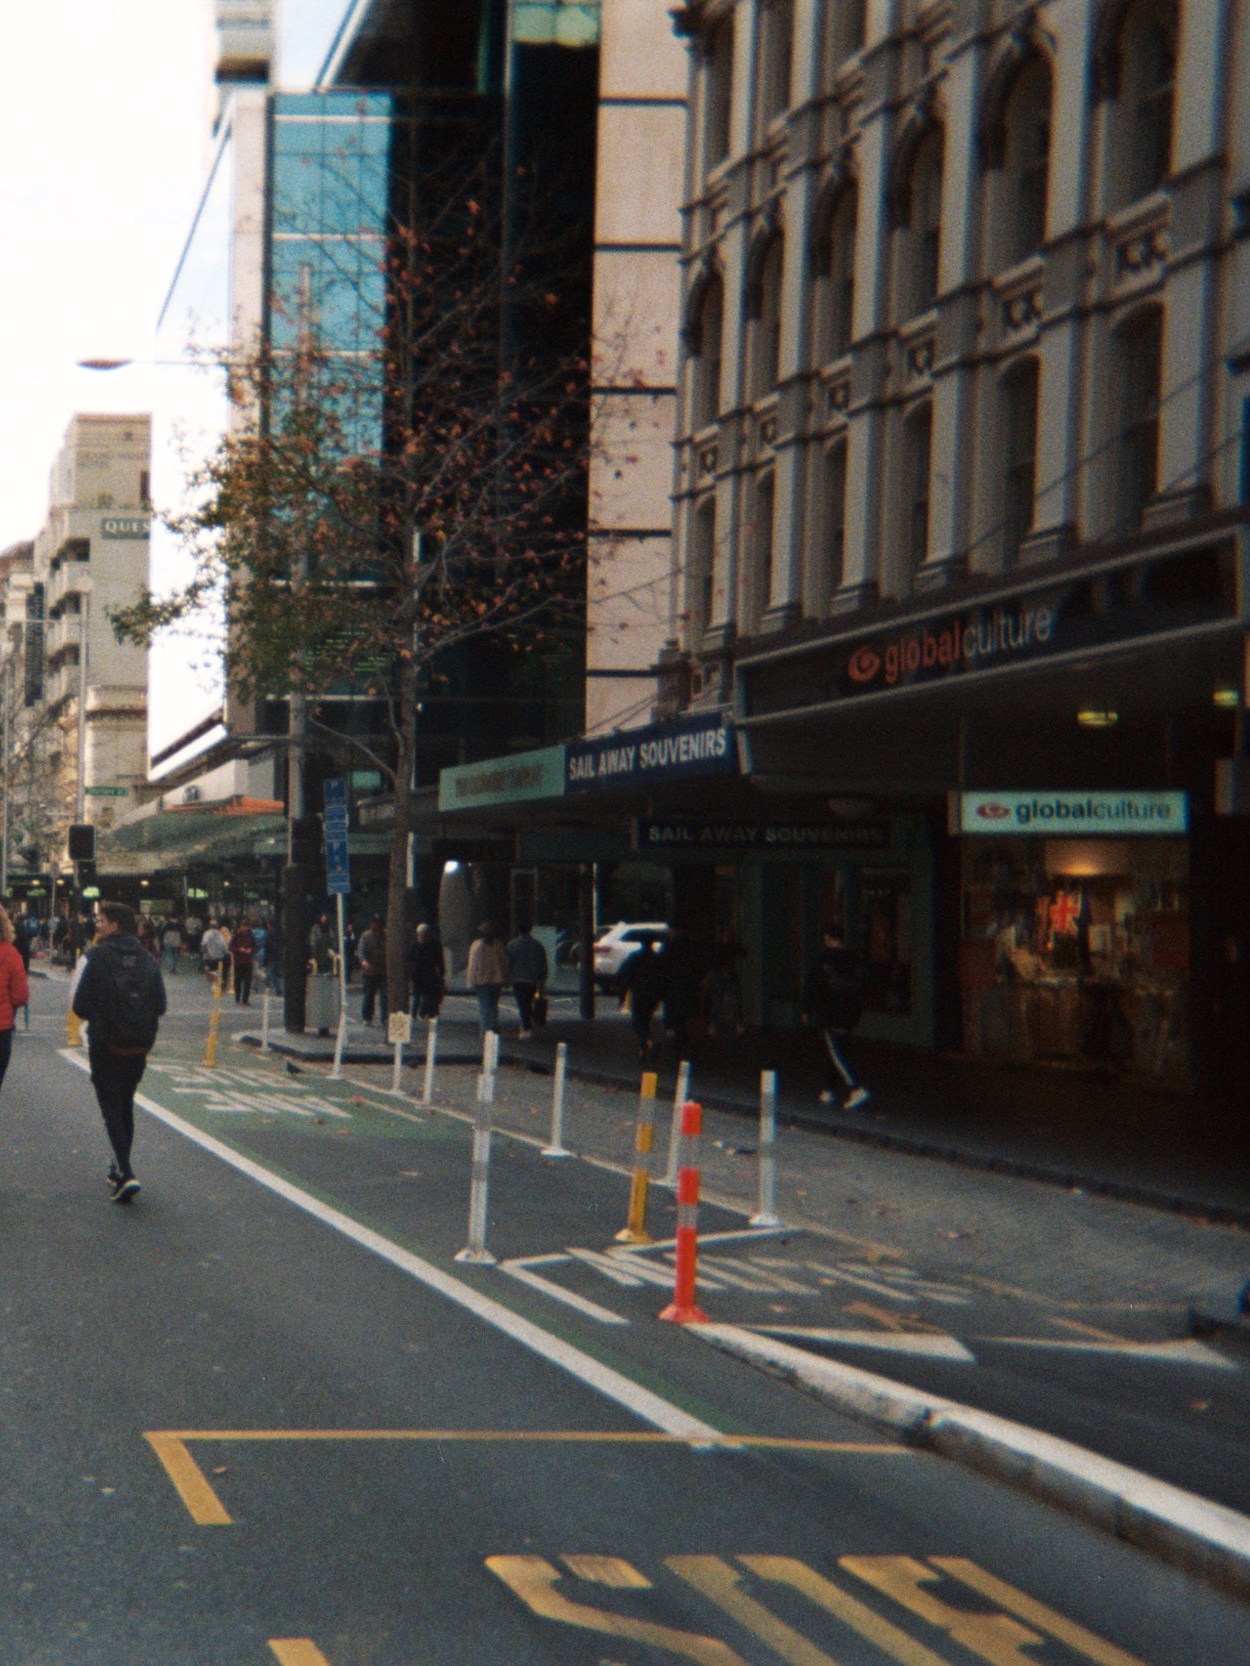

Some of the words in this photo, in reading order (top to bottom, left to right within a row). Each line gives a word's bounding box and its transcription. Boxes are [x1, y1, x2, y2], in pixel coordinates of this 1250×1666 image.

[883, 606, 1054, 685] globalculture
[568, 756, 596, 781] SAIL
[599, 745, 636, 775] AWAY
[640, 727, 728, 769] SOUVENIRS
[1015, 799, 1170, 823] globalculture
[648, 826, 693, 842] SAIL
[699, 826, 758, 842] AWAY
